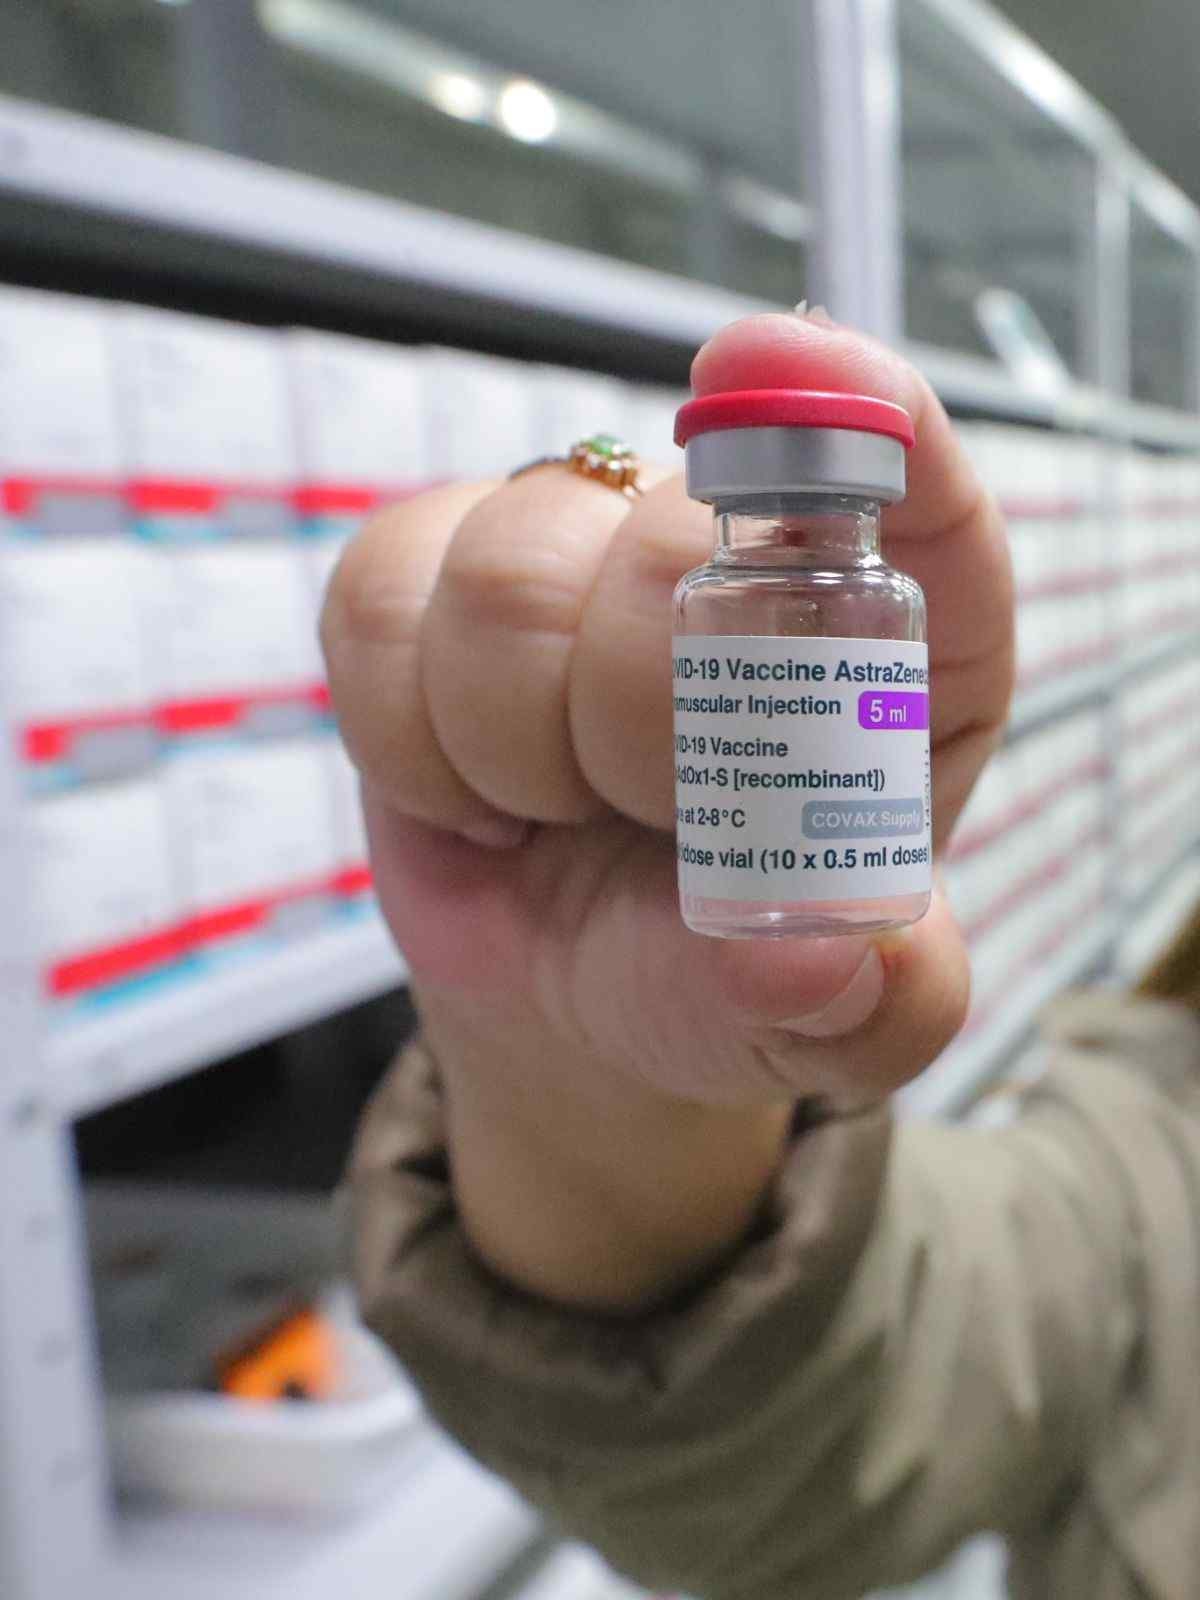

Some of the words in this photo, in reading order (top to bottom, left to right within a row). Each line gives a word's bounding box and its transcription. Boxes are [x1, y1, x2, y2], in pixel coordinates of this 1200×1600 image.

[727, 658, 827, 682] Vaccine
[748, 695, 841, 719] Injection
[869, 699, 883, 723] 5
[889, 704, 907, 723] ml
[710, 737, 788, 757] Vaccine
[734, 768, 885, 791] [recombinant])
[685, 808, 695, 824] at
[811, 811, 878, 829] COVAX
[879, 809, 920, 830] Supply
[719, 848, 753, 868] vial
[760, 848, 795, 874] (10
[803, 854, 817, 869] x
[824, 848, 857, 869] 0.5
[864, 846, 887, 868] ml
